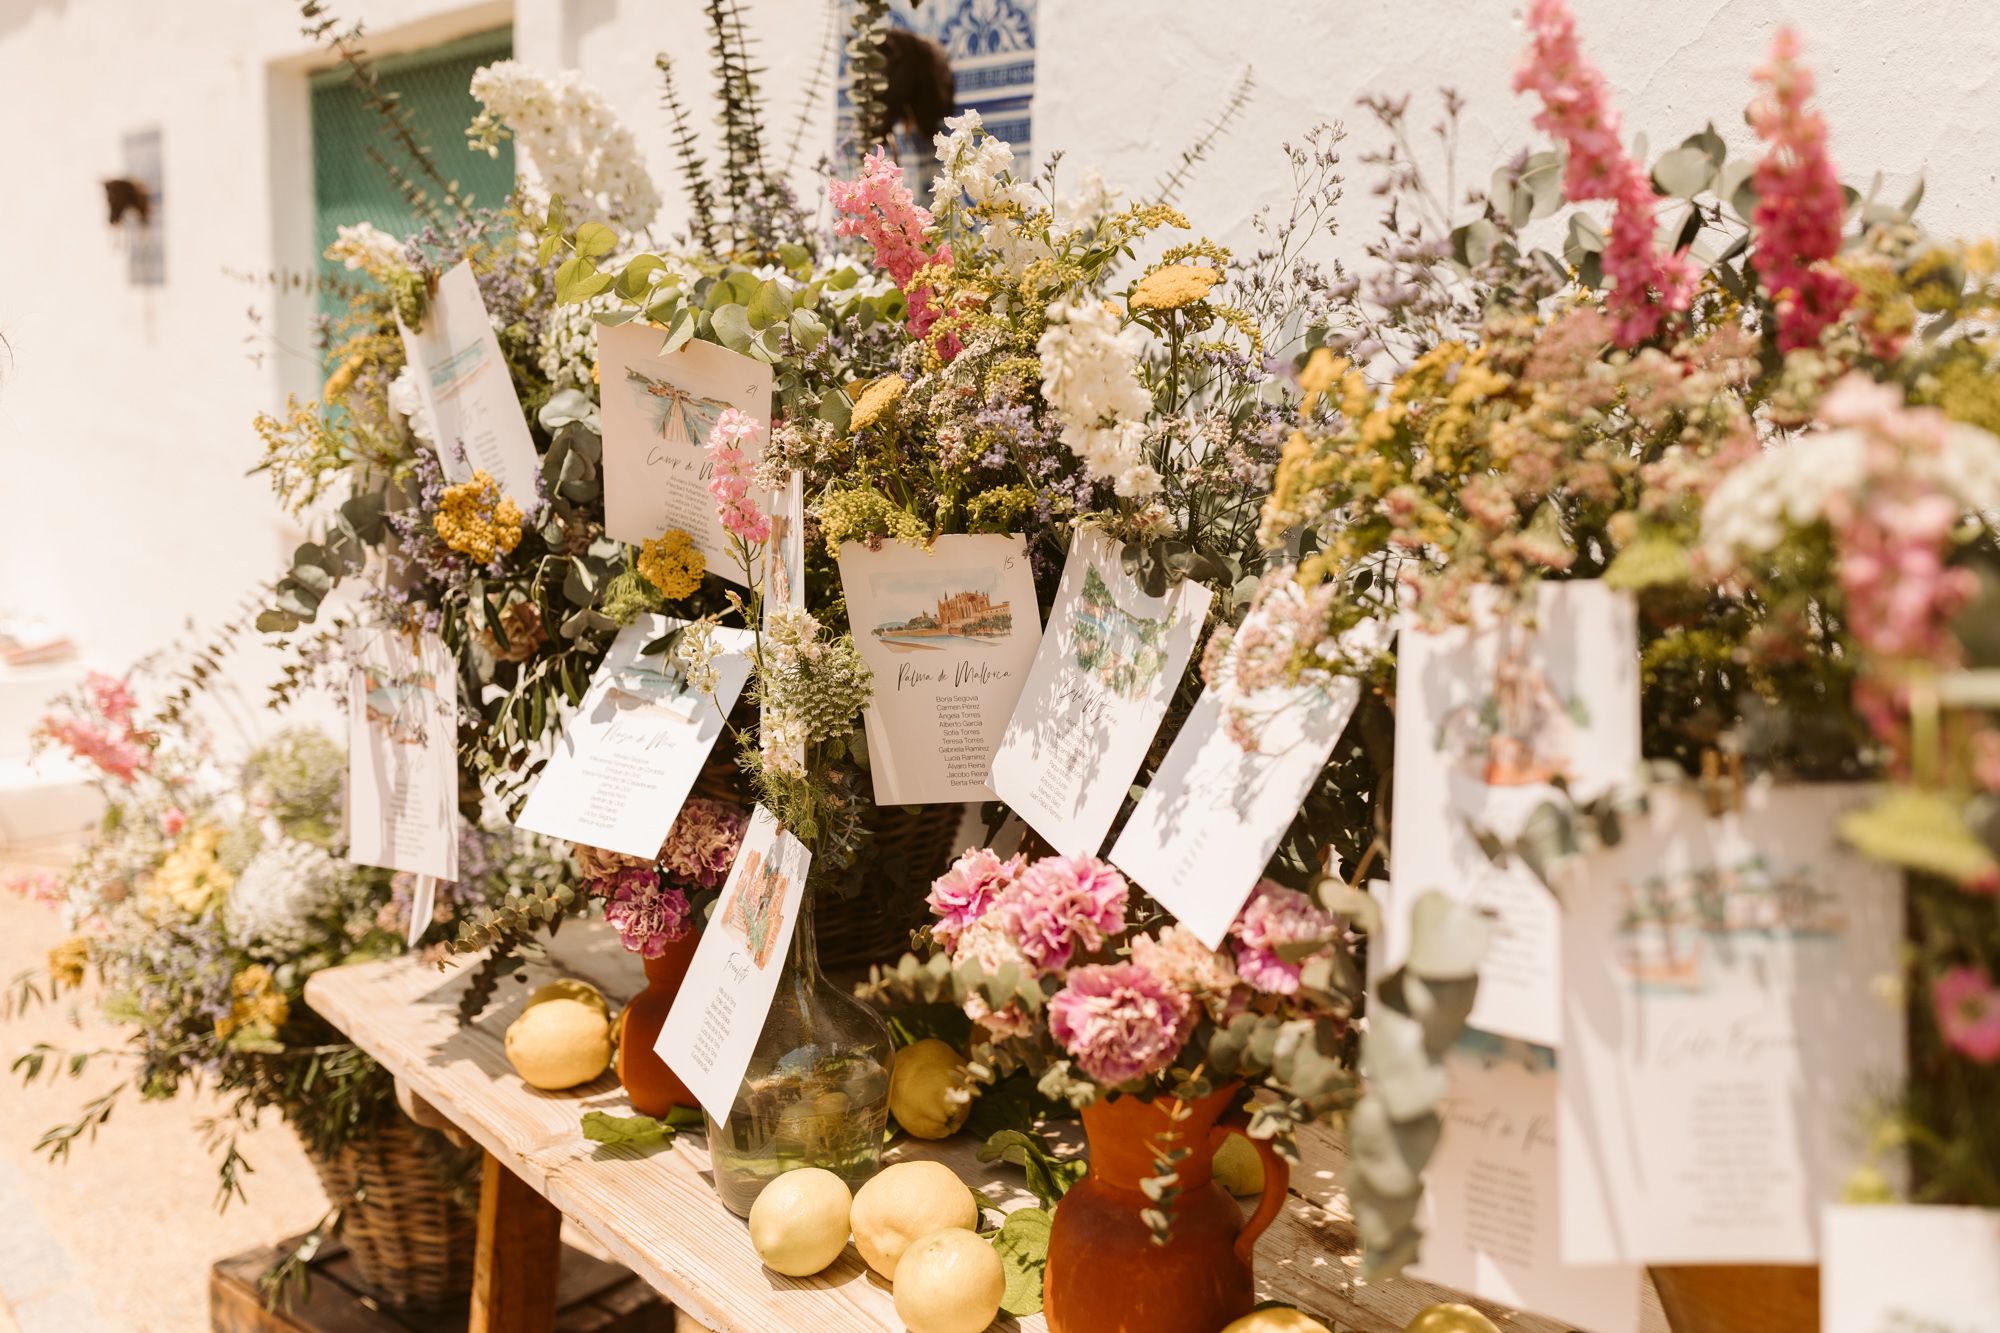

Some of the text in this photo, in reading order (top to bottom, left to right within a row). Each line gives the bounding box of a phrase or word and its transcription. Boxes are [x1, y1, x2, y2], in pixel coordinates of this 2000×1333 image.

[1003, 555, 1015, 570] 15
[898, 660, 1012, 692] Palma de Mallorca
